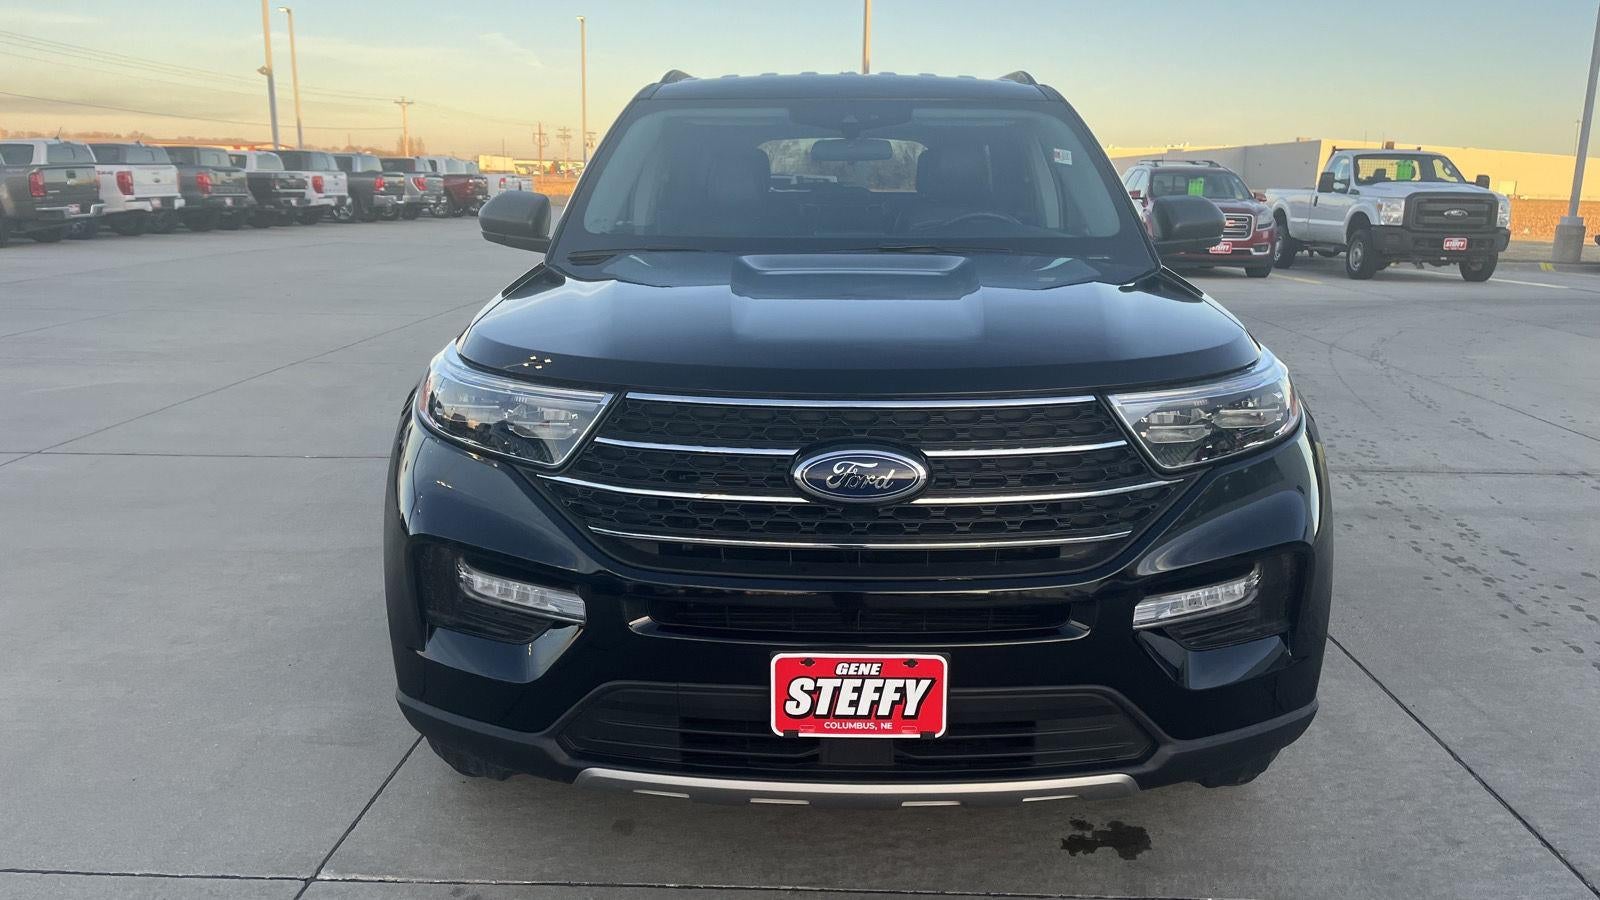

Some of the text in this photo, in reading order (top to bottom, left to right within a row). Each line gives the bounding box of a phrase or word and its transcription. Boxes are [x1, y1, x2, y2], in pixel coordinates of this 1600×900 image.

[826, 461, 895, 489] Ford
[835, 662, 882, 676] GENE
[784, 677, 936, 718] STEFFY
[824, 722, 878, 730] COLUMBUS,
